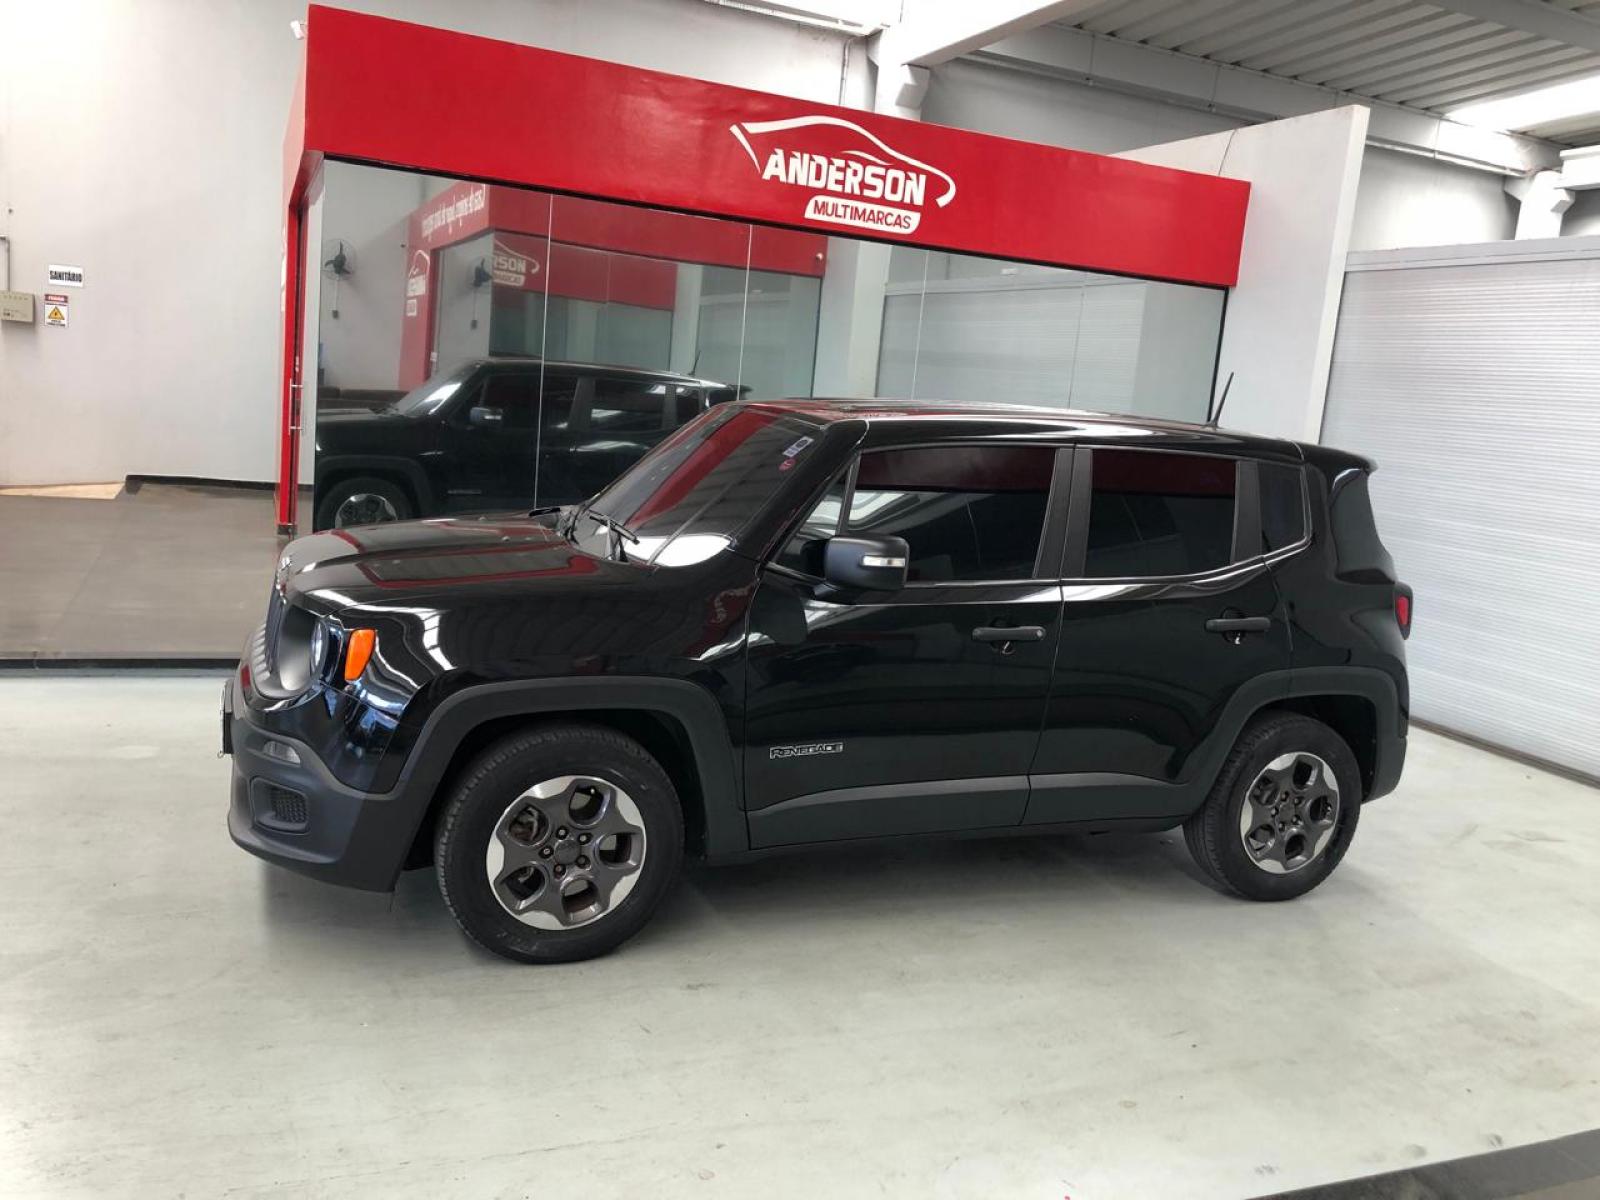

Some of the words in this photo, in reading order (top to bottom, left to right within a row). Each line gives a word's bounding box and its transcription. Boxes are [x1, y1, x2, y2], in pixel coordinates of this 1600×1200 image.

[762, 148, 927, 206] ANDERSON
[813, 200, 911, 230] MULTIMARCAS
[770, 742, 843, 759] RENEGADE
